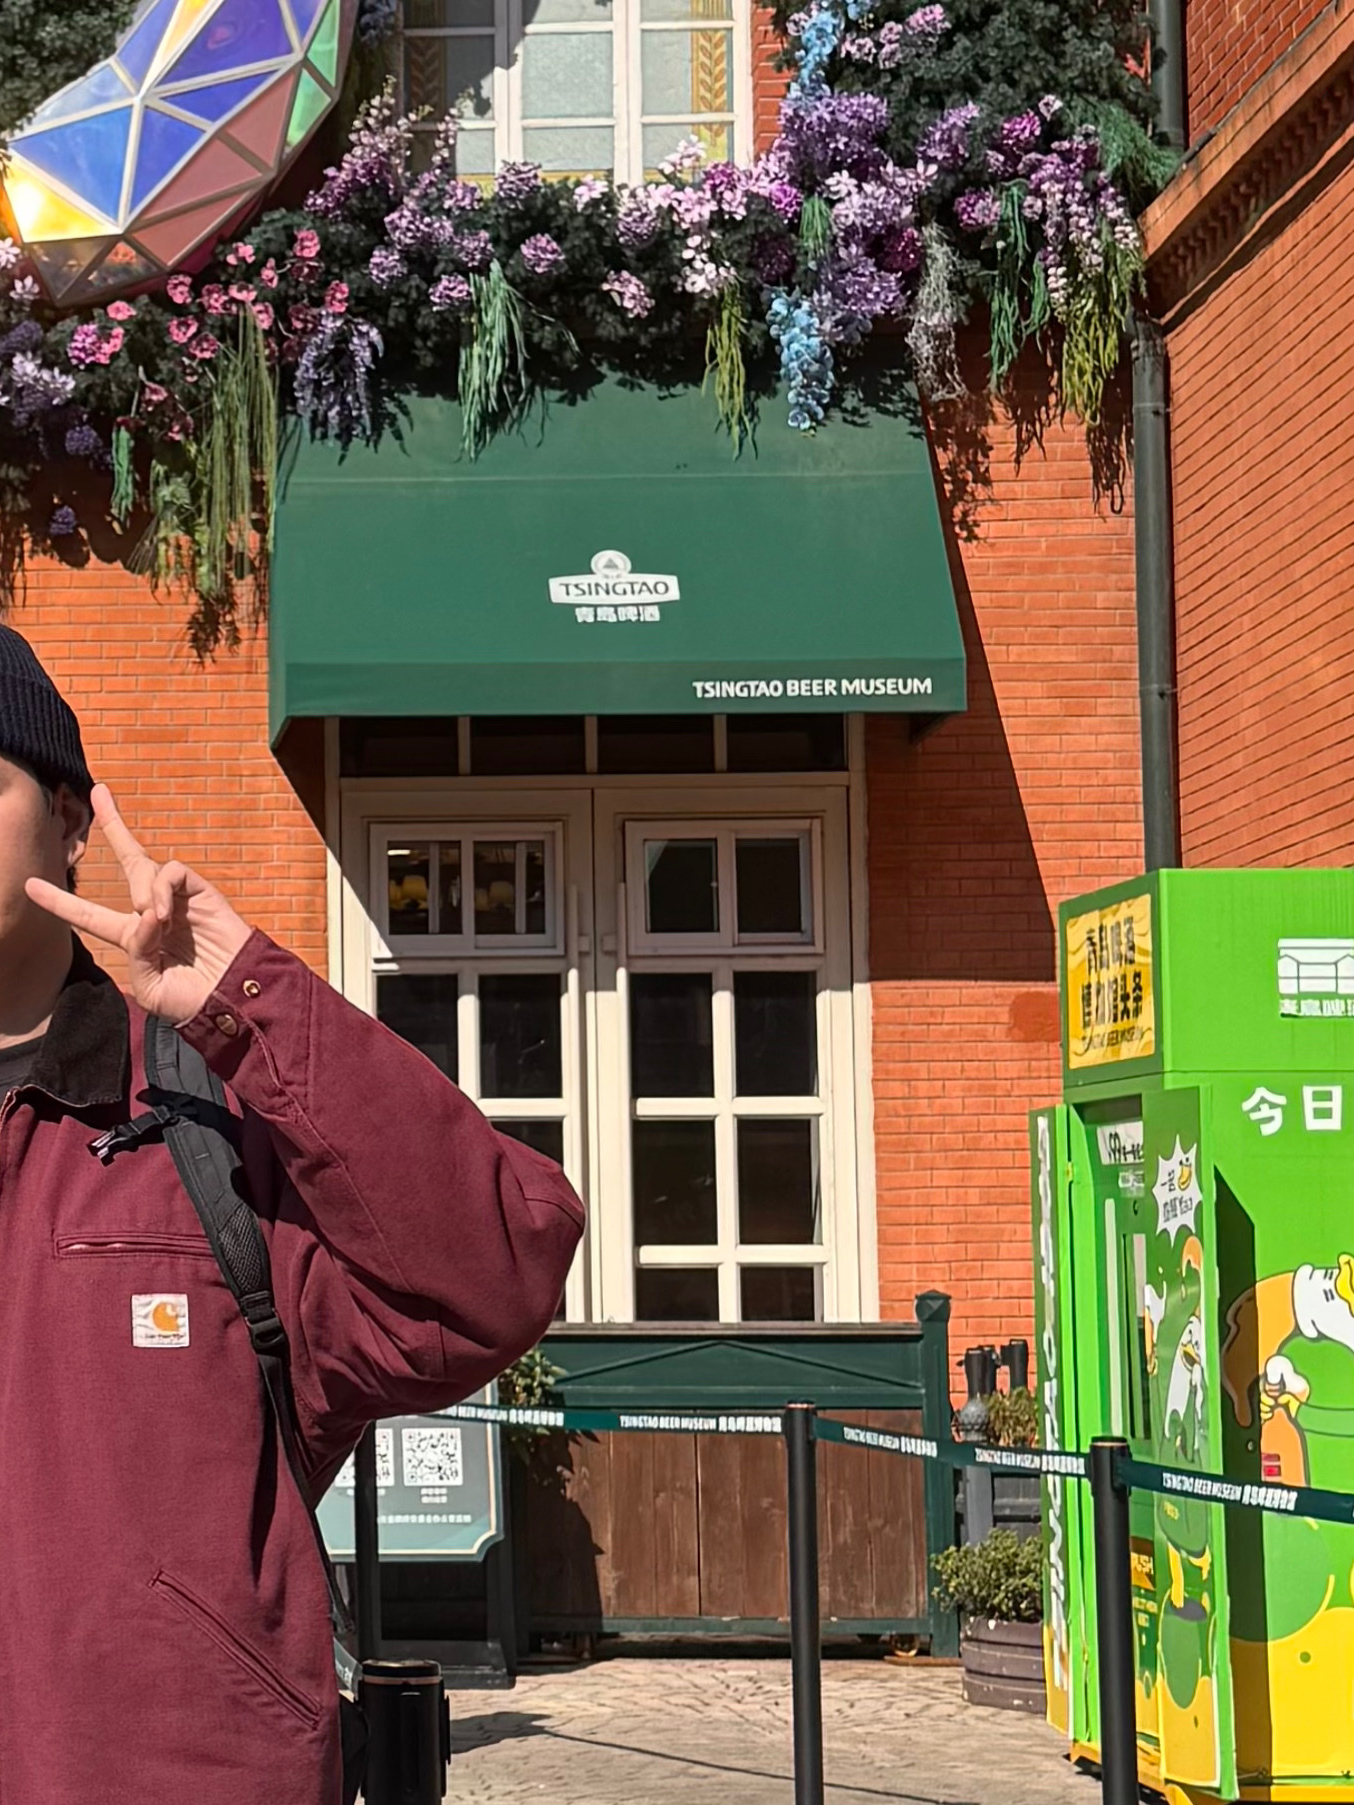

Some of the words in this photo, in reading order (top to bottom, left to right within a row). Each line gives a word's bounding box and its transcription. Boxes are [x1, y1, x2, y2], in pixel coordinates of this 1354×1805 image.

[559, 581, 669, 597] TSINGTAO
[692, 680, 784, 698] TSINGTAO
[786, 679, 837, 697] BEER
[841, 677, 932, 696] MUSEUM
[1242, 1085, 1343, 1137] 今日
